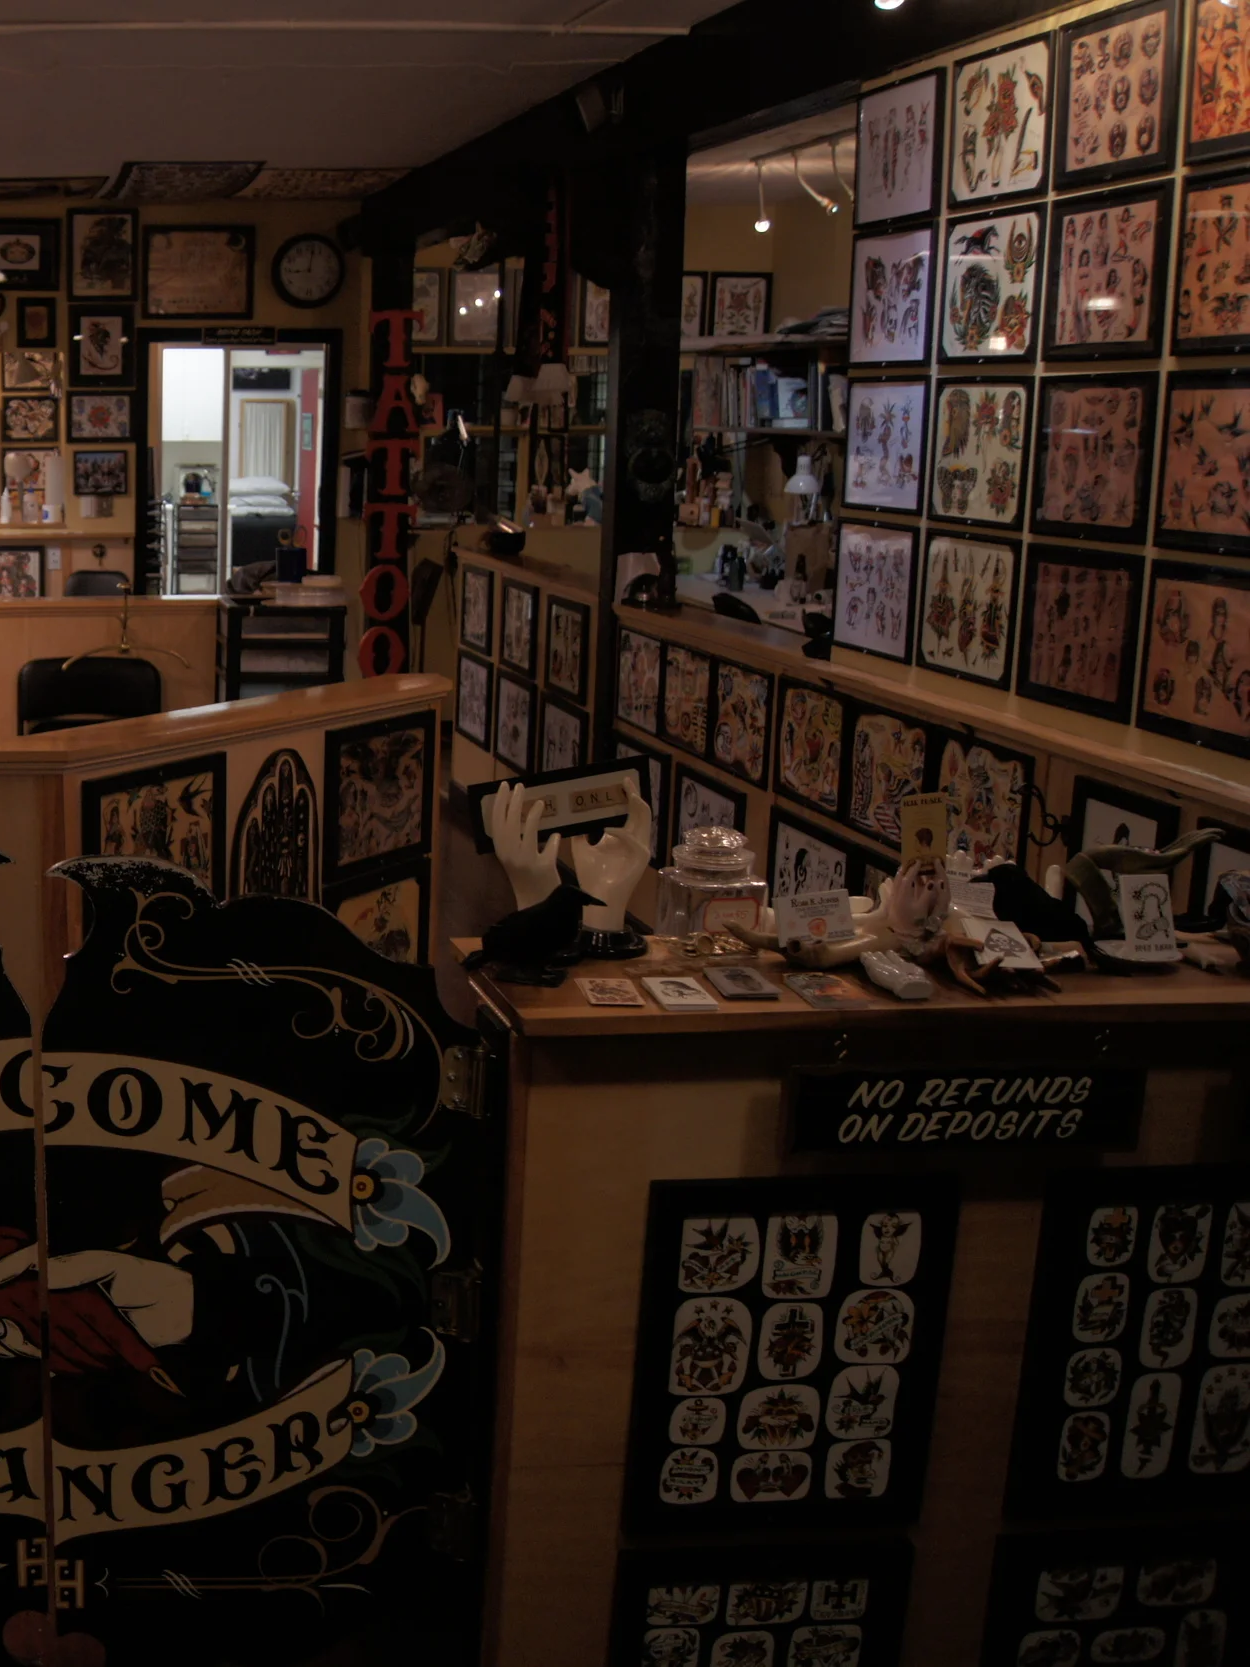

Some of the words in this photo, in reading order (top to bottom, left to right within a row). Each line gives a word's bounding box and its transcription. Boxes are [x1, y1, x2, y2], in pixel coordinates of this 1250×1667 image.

[358, 309, 424, 678] TATTOO
[847, 1079, 905, 1109] NO
[915, 1075, 1093, 1108] REFUNDS
[837, 1113, 895, 1144] ON
[897, 1107, 1084, 1142] DEPOSITS
